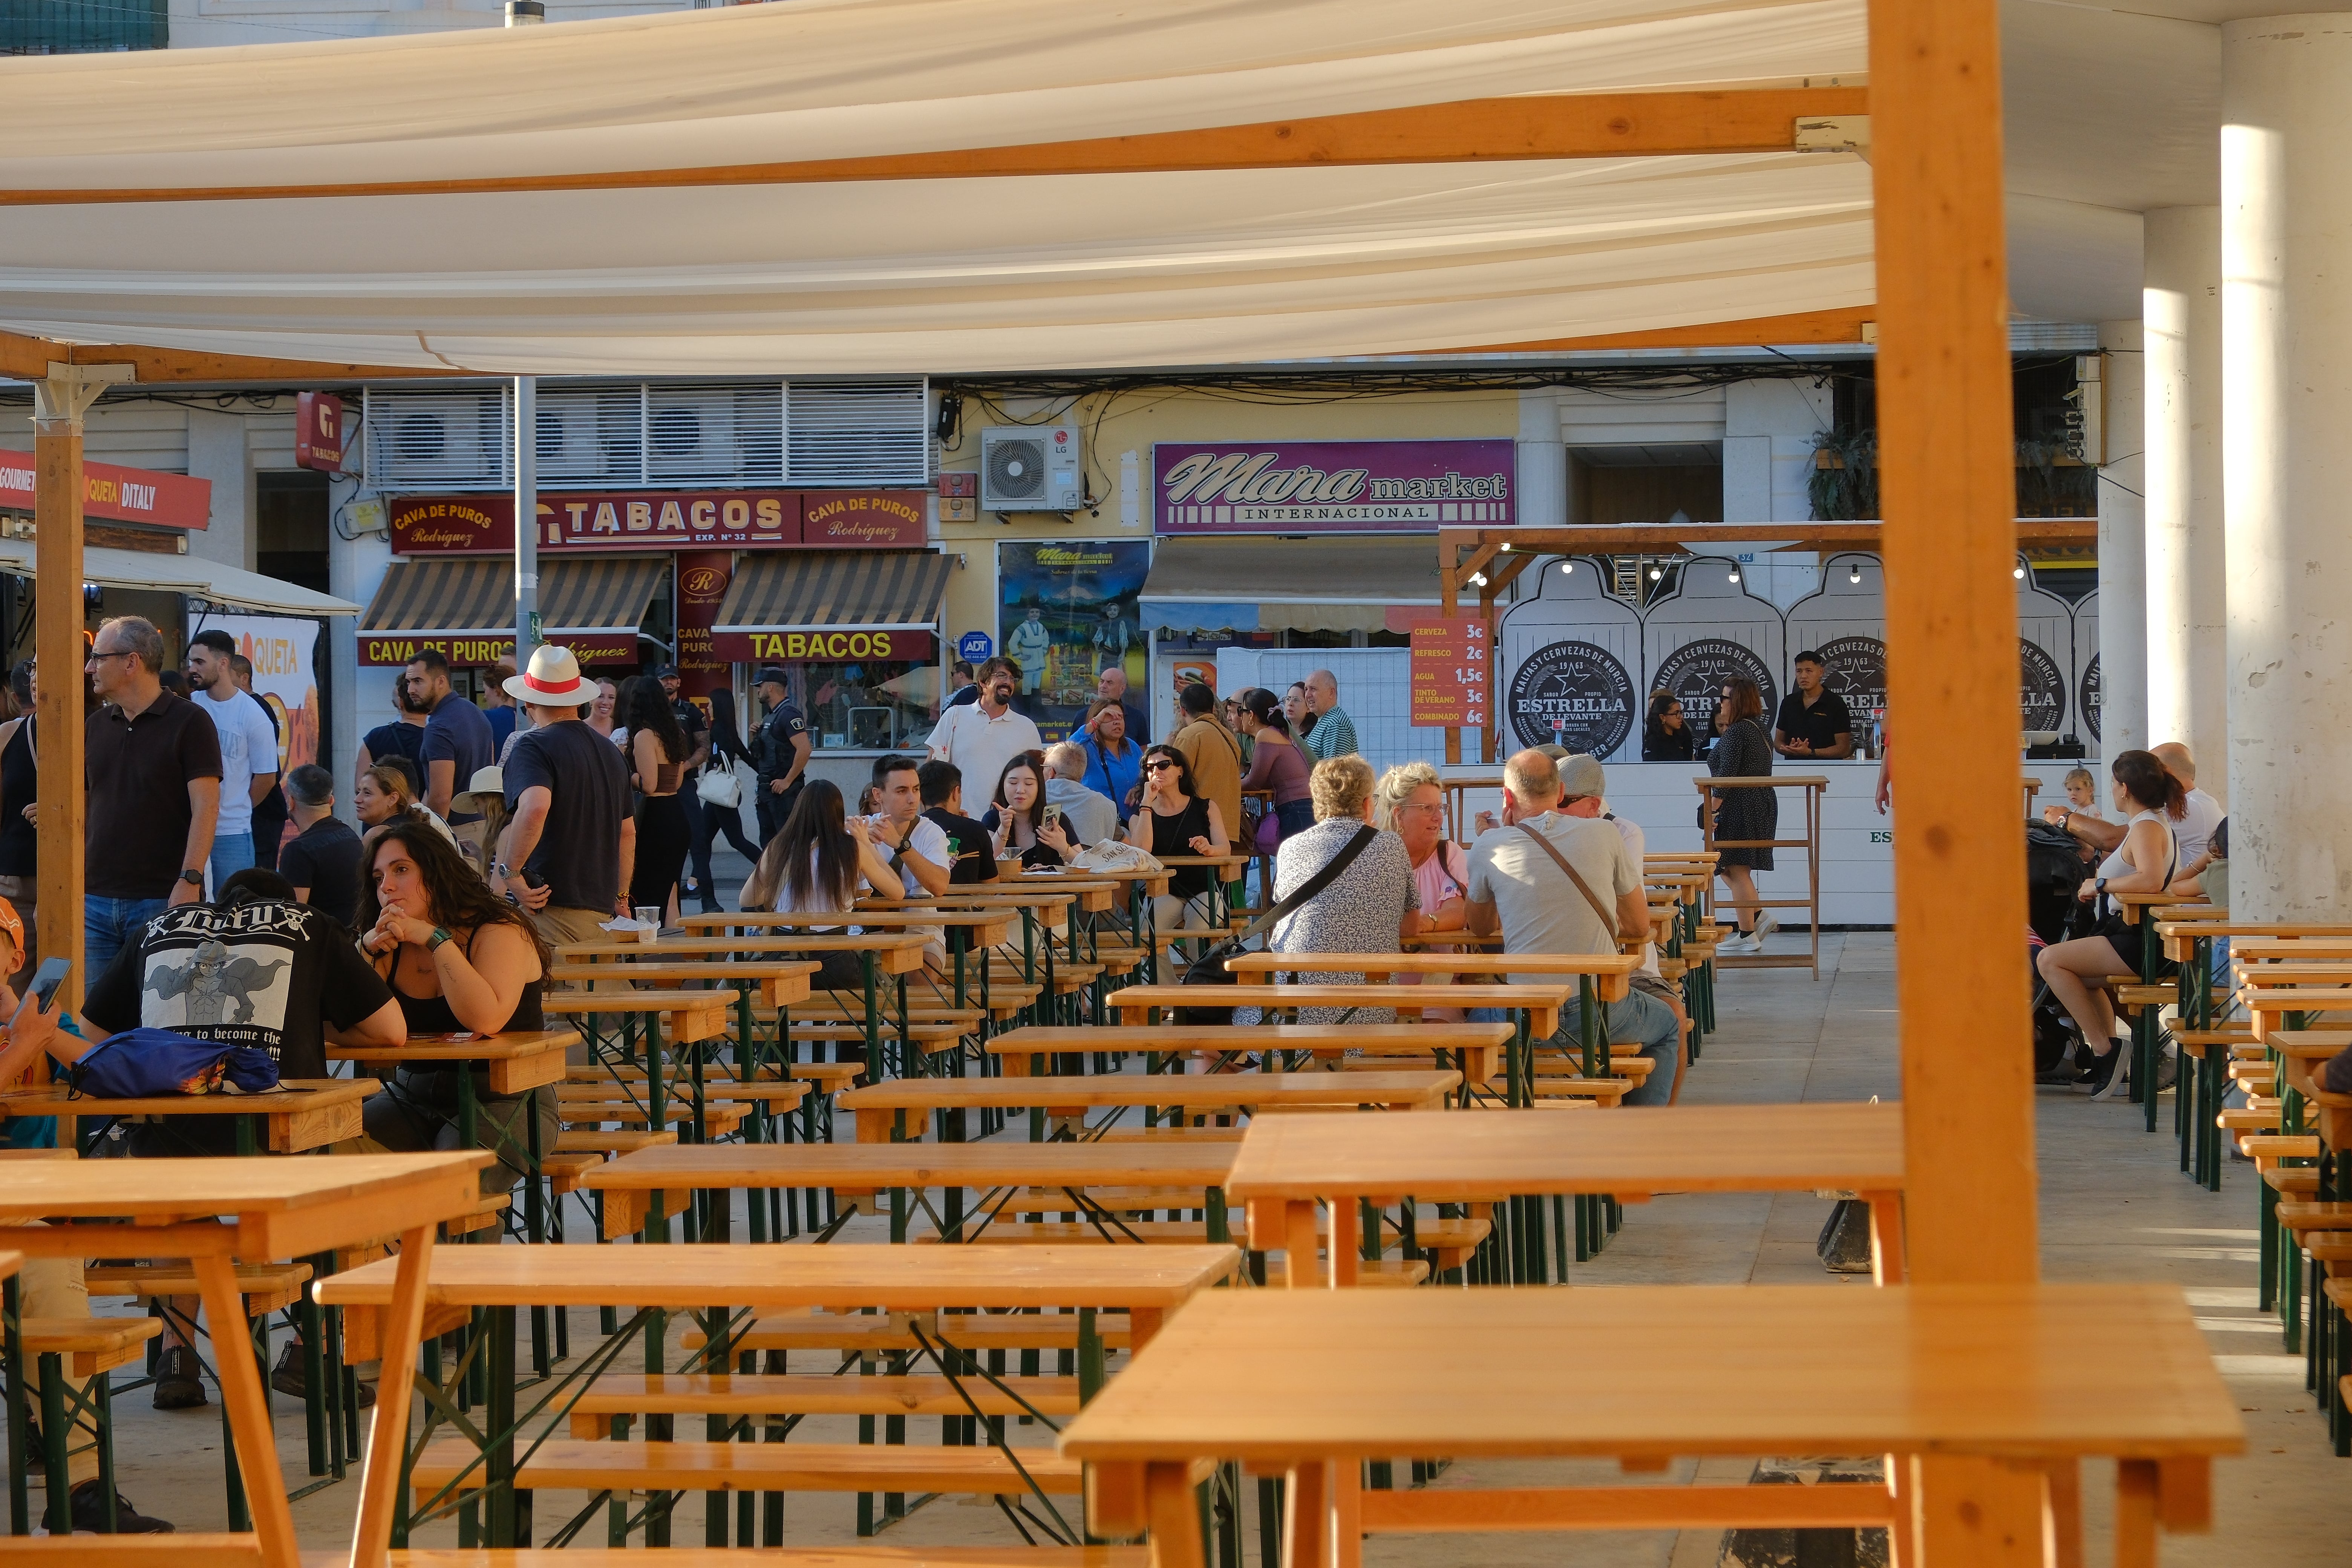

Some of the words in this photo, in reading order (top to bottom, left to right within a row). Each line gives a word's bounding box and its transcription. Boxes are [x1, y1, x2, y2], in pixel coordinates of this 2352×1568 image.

[312, 446, 340, 462] TABACOS
[0, 467, 35, 492] GOURMET
[1164, 452, 1369, 504] Mara
[1370, 472, 1507, 501] market
[121, 482, 155, 510] DITALY
[395, 507, 427, 530] CAVA
[429, 504, 446, 518] DE
[449, 505, 492, 529] PUROS
[565, 498, 782, 532] TABACOS
[808, 500, 846, 523] CAVA
[849, 498, 867, 511] DE
[872, 498, 919, 523] PUROS
[1245, 507, 1429, 519] INTERNACIONAL
[827, 521, 899, 541] Rodríguez
[1036, 548, 1082, 560] Mara
[689, 571, 715, 590] R
[677, 628, 710, 639] CAVA
[1467, 625, 1482, 638] 3€
[369, 641, 415, 662] CAVA
[749, 632, 891, 658] TABACOS
[965, 641, 987, 652] ADT
[1467, 646, 1482, 660] 2€
[1820, 652, 1827, 661] Y
[1827, 642, 1876, 657] CERVEZAS
[1515, 662, 1538, 694] MALTAS
[1536, 656, 1543, 665] Y
[1544, 646, 1591, 661] CERVEZAS
[1591, 651, 1604, 663] DE
[1603, 660, 1628, 693] MURCIA
[1677, 654, 1684, 663] Y
[1685, 644, 1732, 659] CERVEZAS
[1733, 649, 1746, 661] DE
[1745, 657, 1770, 691] MURCIA
[2021, 645, 2034, 658] DE
[2033, 653, 2058, 687] MURCIA
[1455, 668, 1482, 684] 1,5€
[1467, 689, 1482, 703] 3€
[1517, 698, 1627, 714] ESTRELLA
[1467, 709, 1482, 723] 6€
[1102, 850, 1118, 862] SAN
[197, 1029, 208, 1040] to
[214, 1027, 258, 1040] become
[264, 1031, 281, 1045] the
